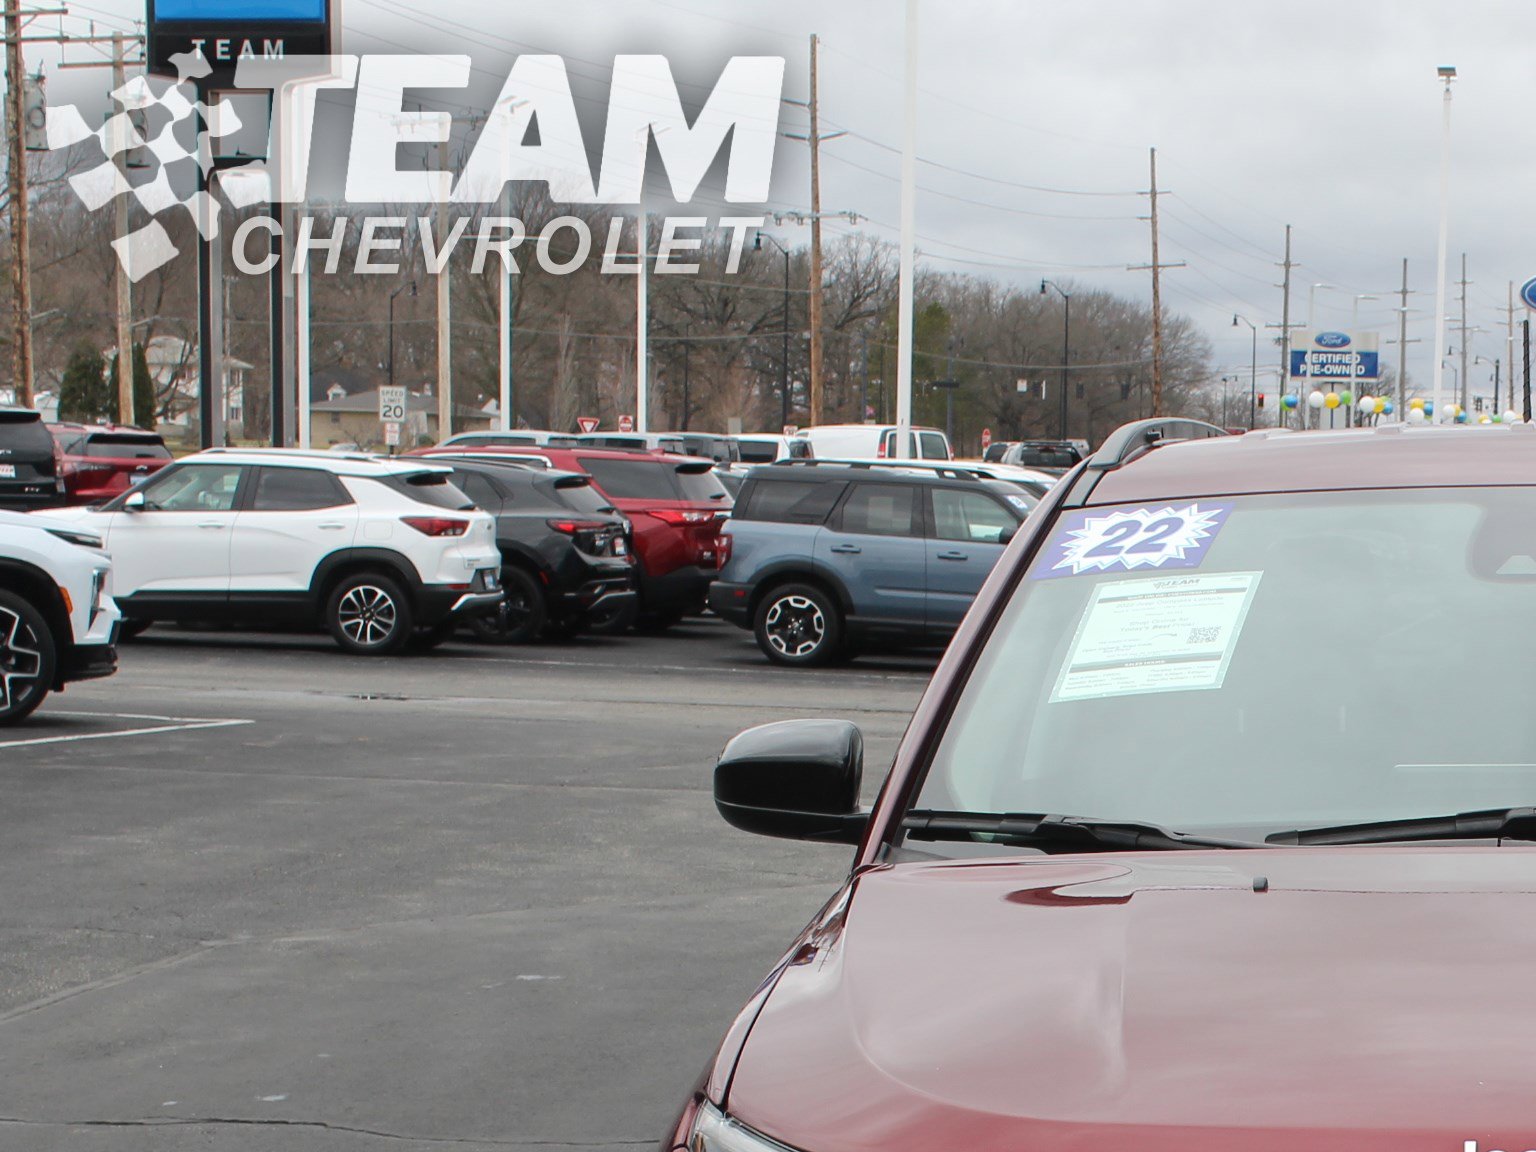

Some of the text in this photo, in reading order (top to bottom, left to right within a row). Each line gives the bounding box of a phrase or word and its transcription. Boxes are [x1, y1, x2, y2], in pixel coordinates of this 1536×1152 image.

[191, 39, 284, 60] TEAM
[1299, 364, 1366, 375] PE-OWND
[383, 404, 404, 419] 20
[1082, 516, 1185, 559] 22
